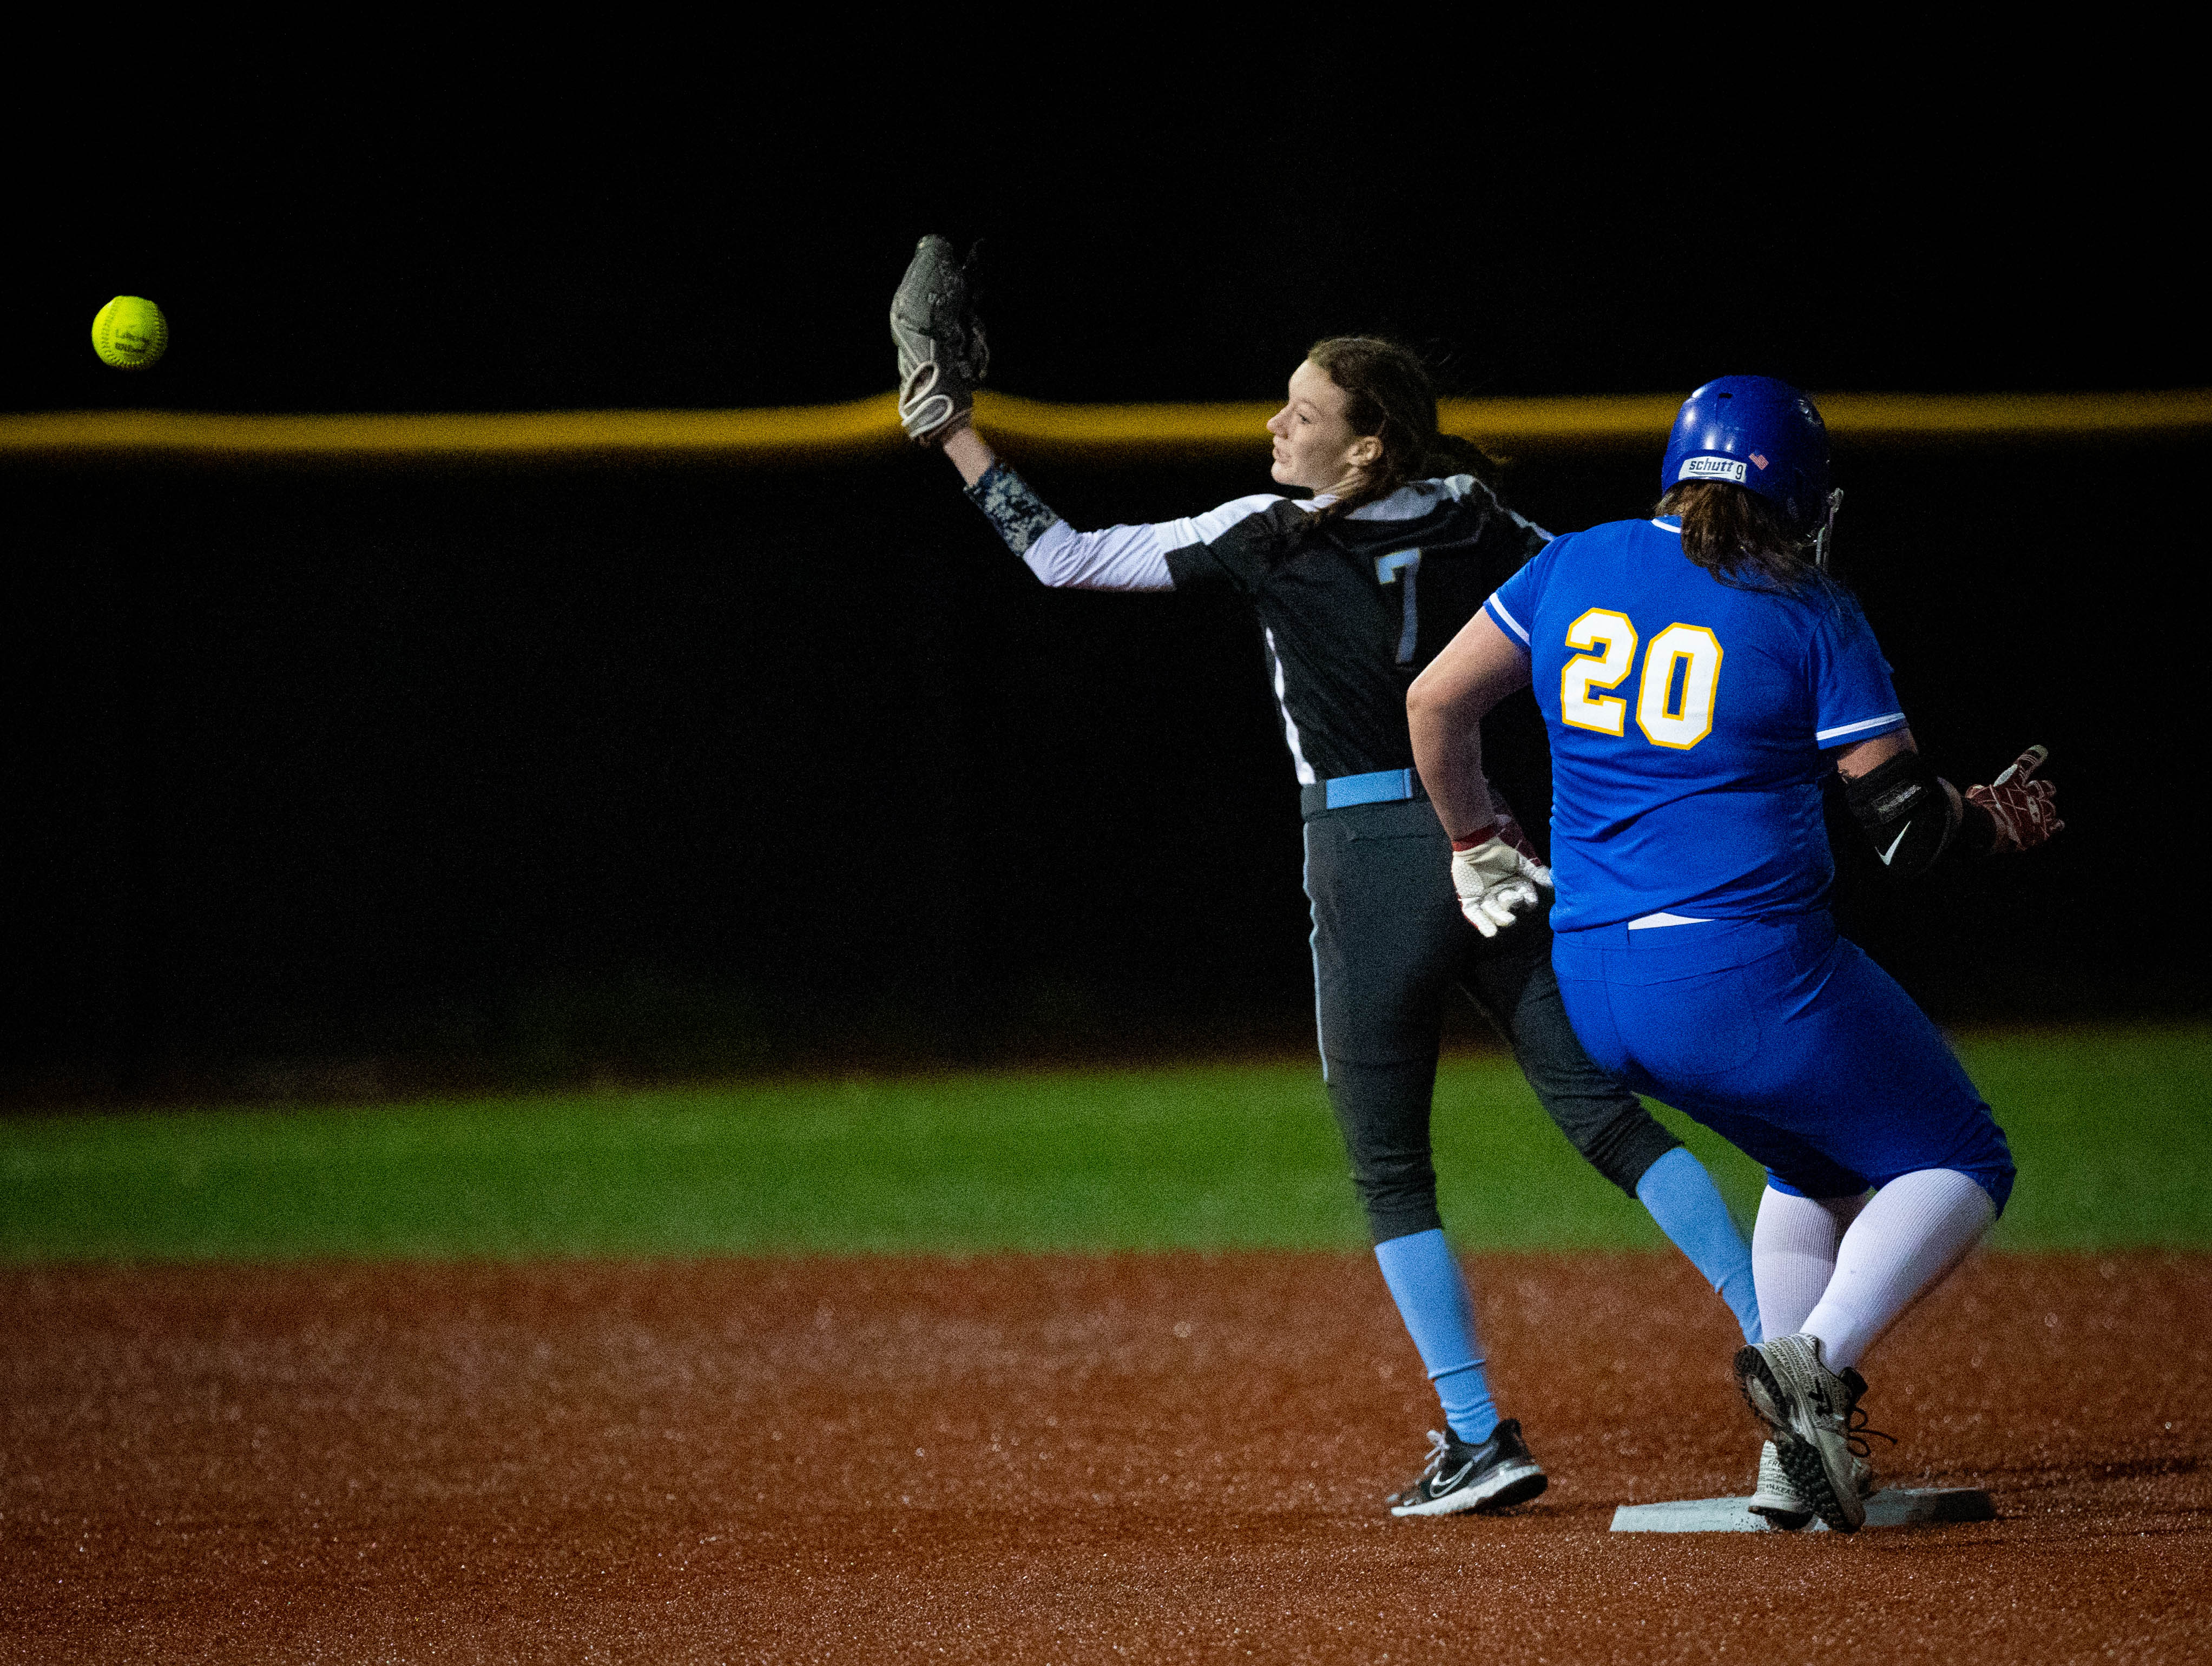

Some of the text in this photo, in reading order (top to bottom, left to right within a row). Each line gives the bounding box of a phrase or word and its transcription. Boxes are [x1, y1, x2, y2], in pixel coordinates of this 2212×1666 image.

[1689, 458, 1734, 472] schutt
[1374, 545, 1421, 664] 7
[1561, 607, 1723, 750] 20
